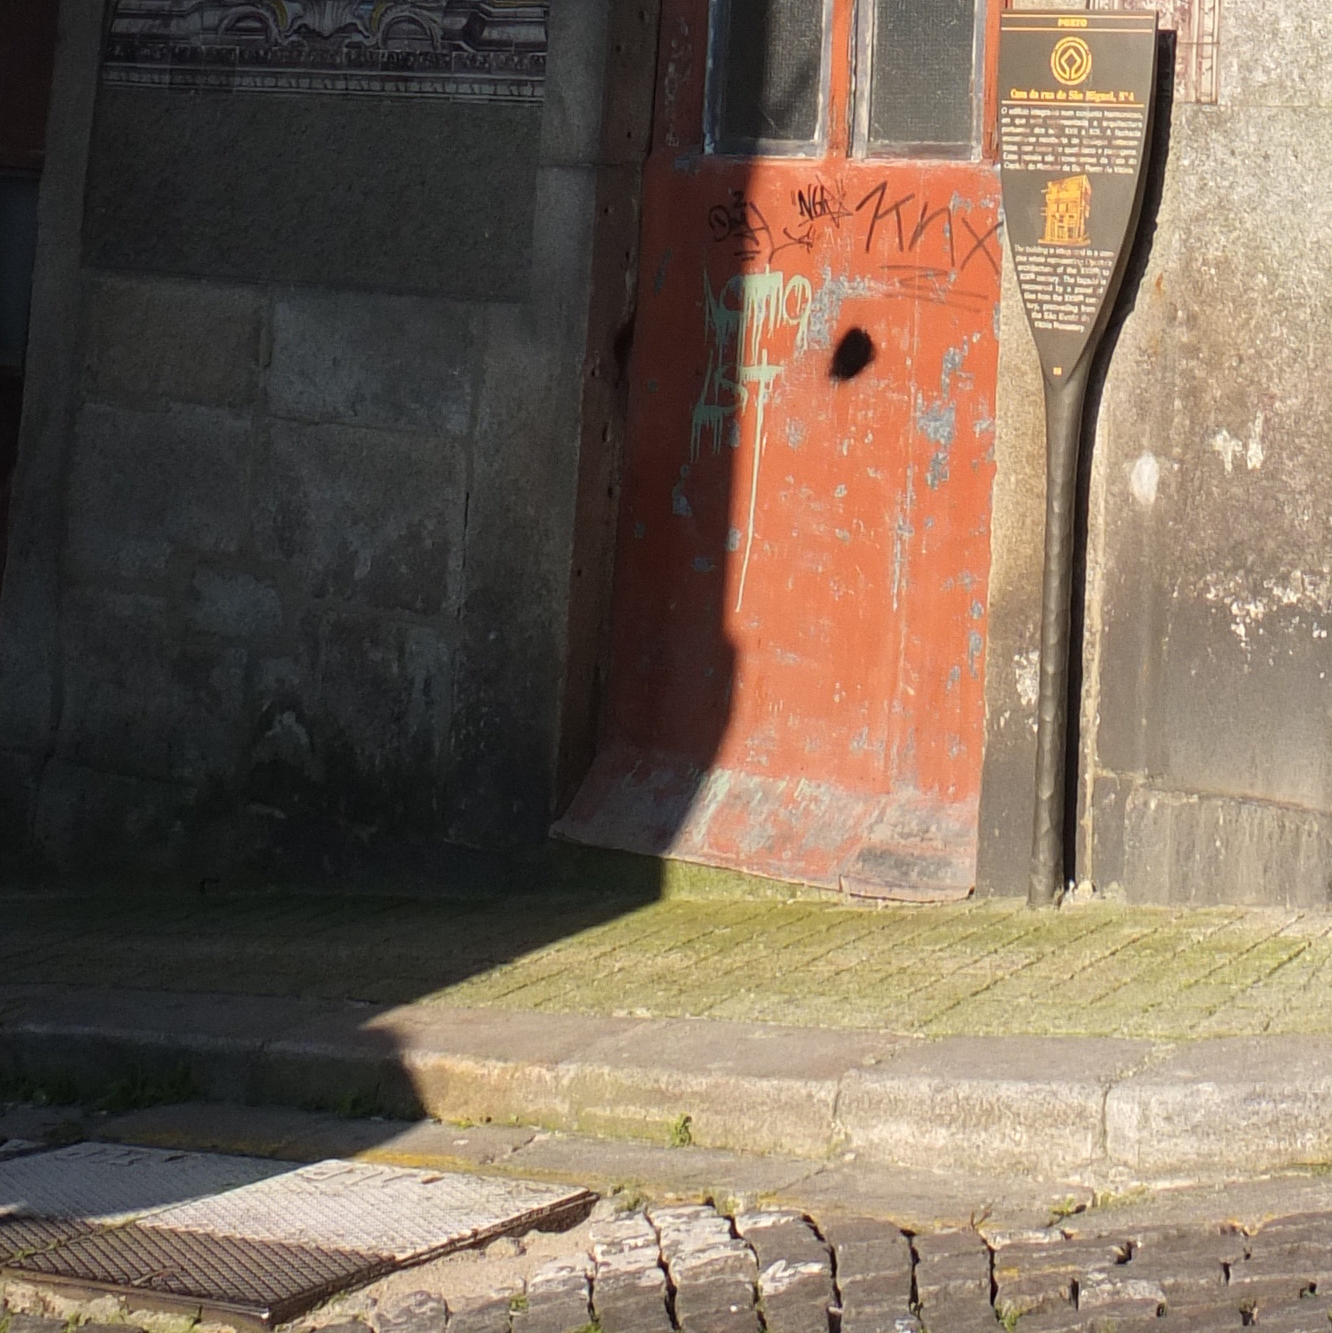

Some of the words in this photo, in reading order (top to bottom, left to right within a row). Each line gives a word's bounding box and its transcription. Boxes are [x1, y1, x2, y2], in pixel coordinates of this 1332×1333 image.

[1057, 18, 1088, 27] PORTO
[1041, 90, 1055, 100] rua
[1068, 89, 1083, 100] São
[1085, 90, 1116, 103] Miguel,
